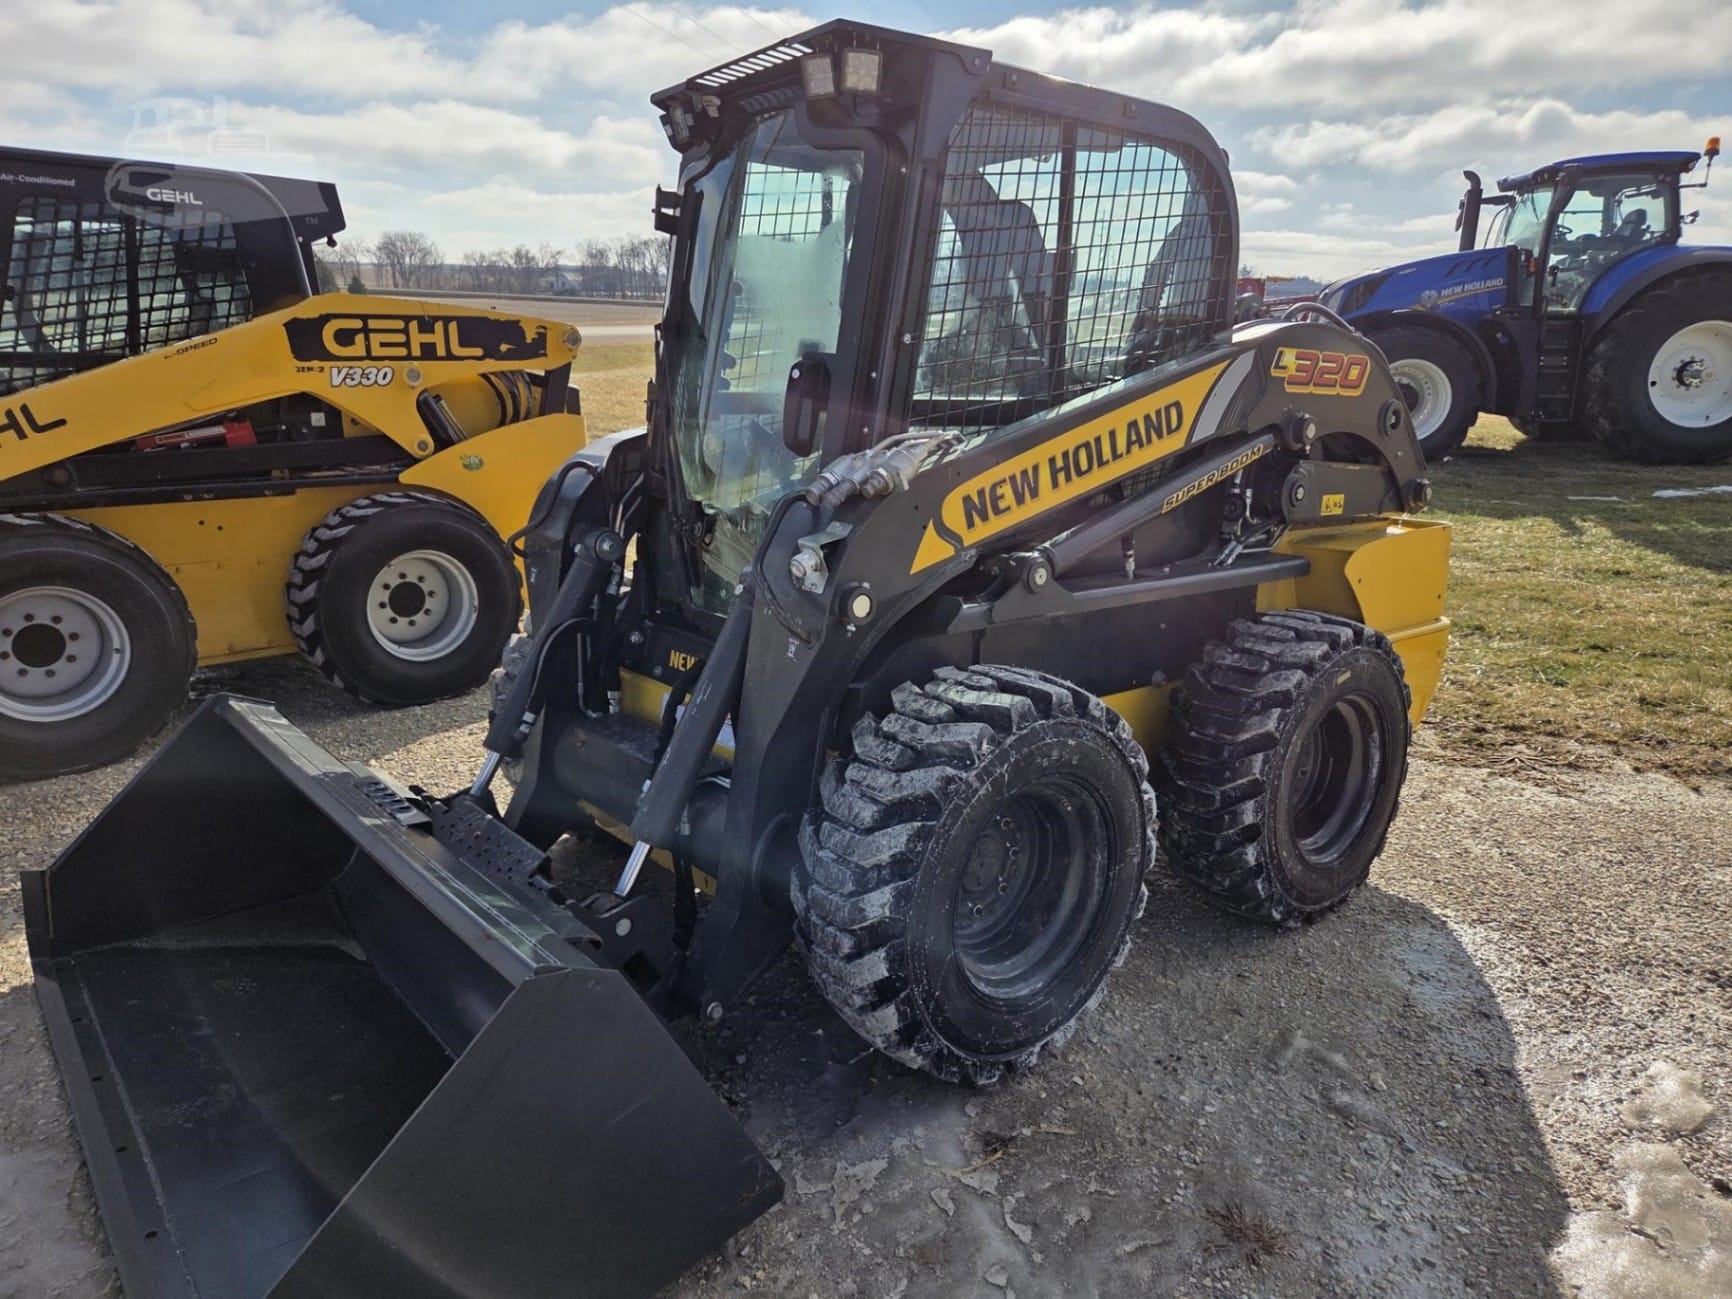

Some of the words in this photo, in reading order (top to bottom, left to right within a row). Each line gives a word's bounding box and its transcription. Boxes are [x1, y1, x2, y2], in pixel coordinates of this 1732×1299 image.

[146, 188, 203, 205] GEHL
[1441, 285, 1463, 297] NEW
[1464, 277, 1504, 292] HOLLAND
[322, 318, 484, 357] GEHL
[330, 366, 394, 388] V330
[1271, 347, 1371, 396] L320
[961, 463, 1040, 530] NEW
[1048, 400, 1184, 490] HOLLAND
